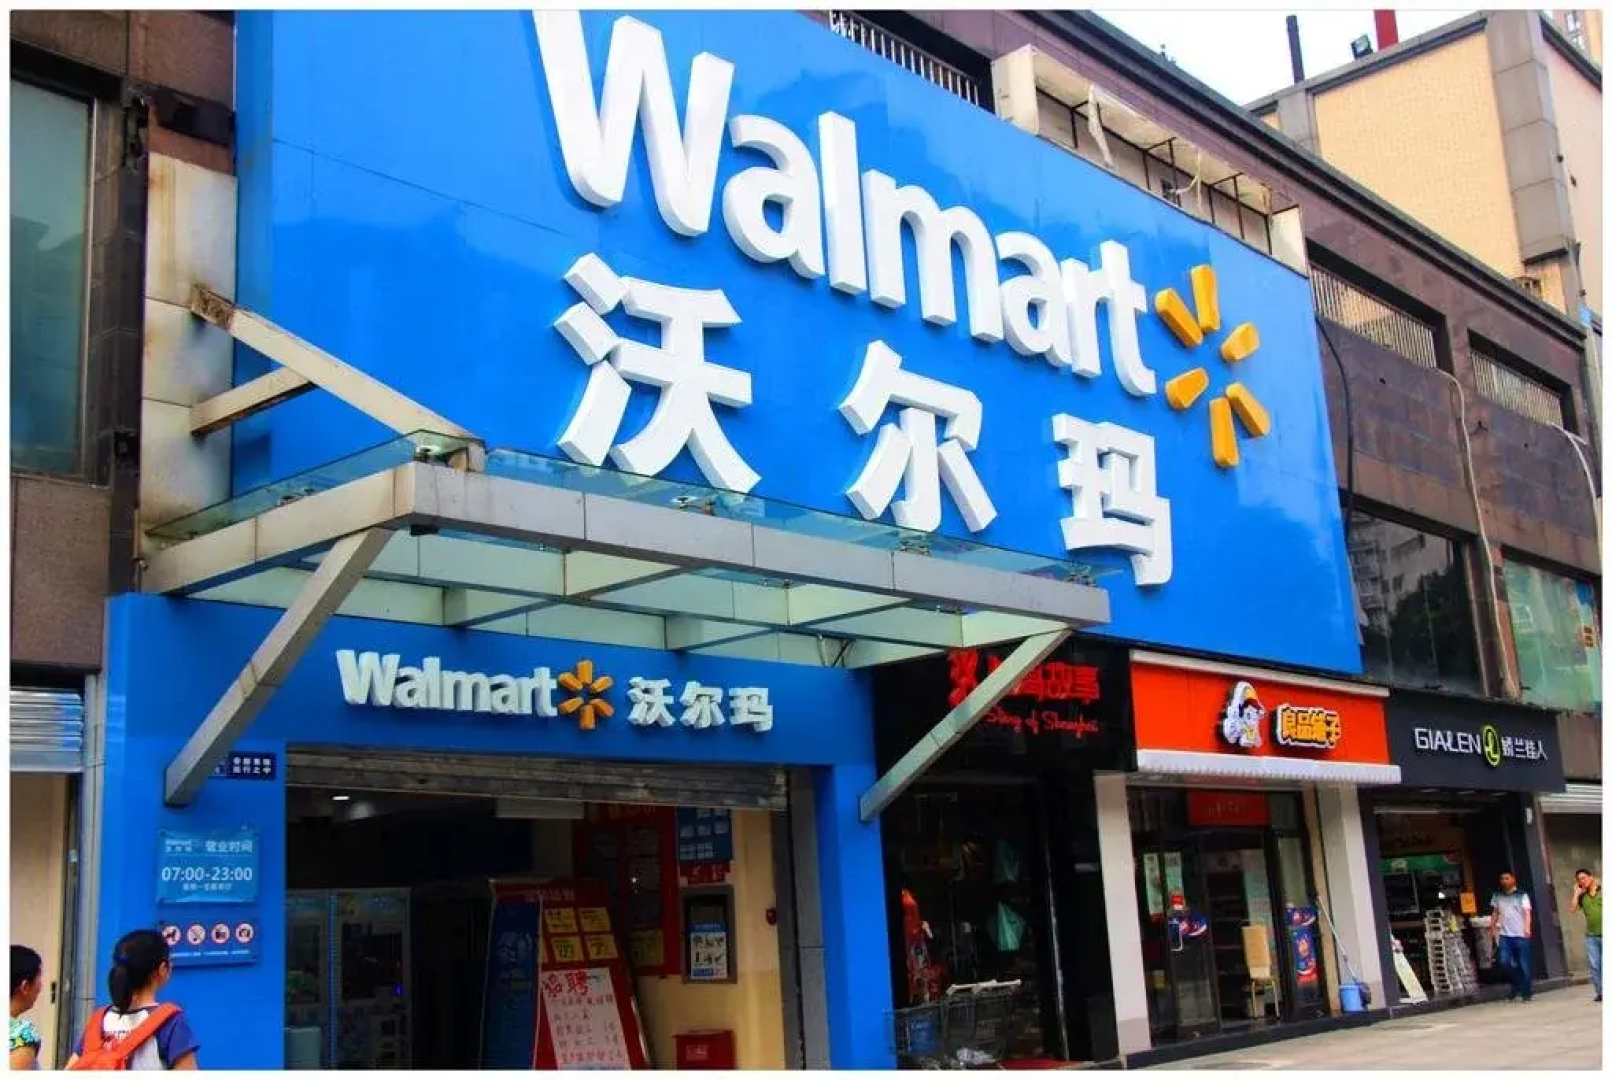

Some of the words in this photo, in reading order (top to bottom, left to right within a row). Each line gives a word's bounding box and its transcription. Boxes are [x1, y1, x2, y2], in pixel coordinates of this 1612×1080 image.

[532, 10, 1156, 398] Walmart
[554, 252, 1173, 587] 沃尔玛
[336, 649, 559, 718] Walmart
[627, 676, 774, 733] 沃尔玛
[1280, 707, 1341, 746] 良品铺子
[1414, 727, 1482, 755] GIALEN
[205, 840, 253, 853] 营业时间
[161, 866, 253, 881] 07:00-23:00
